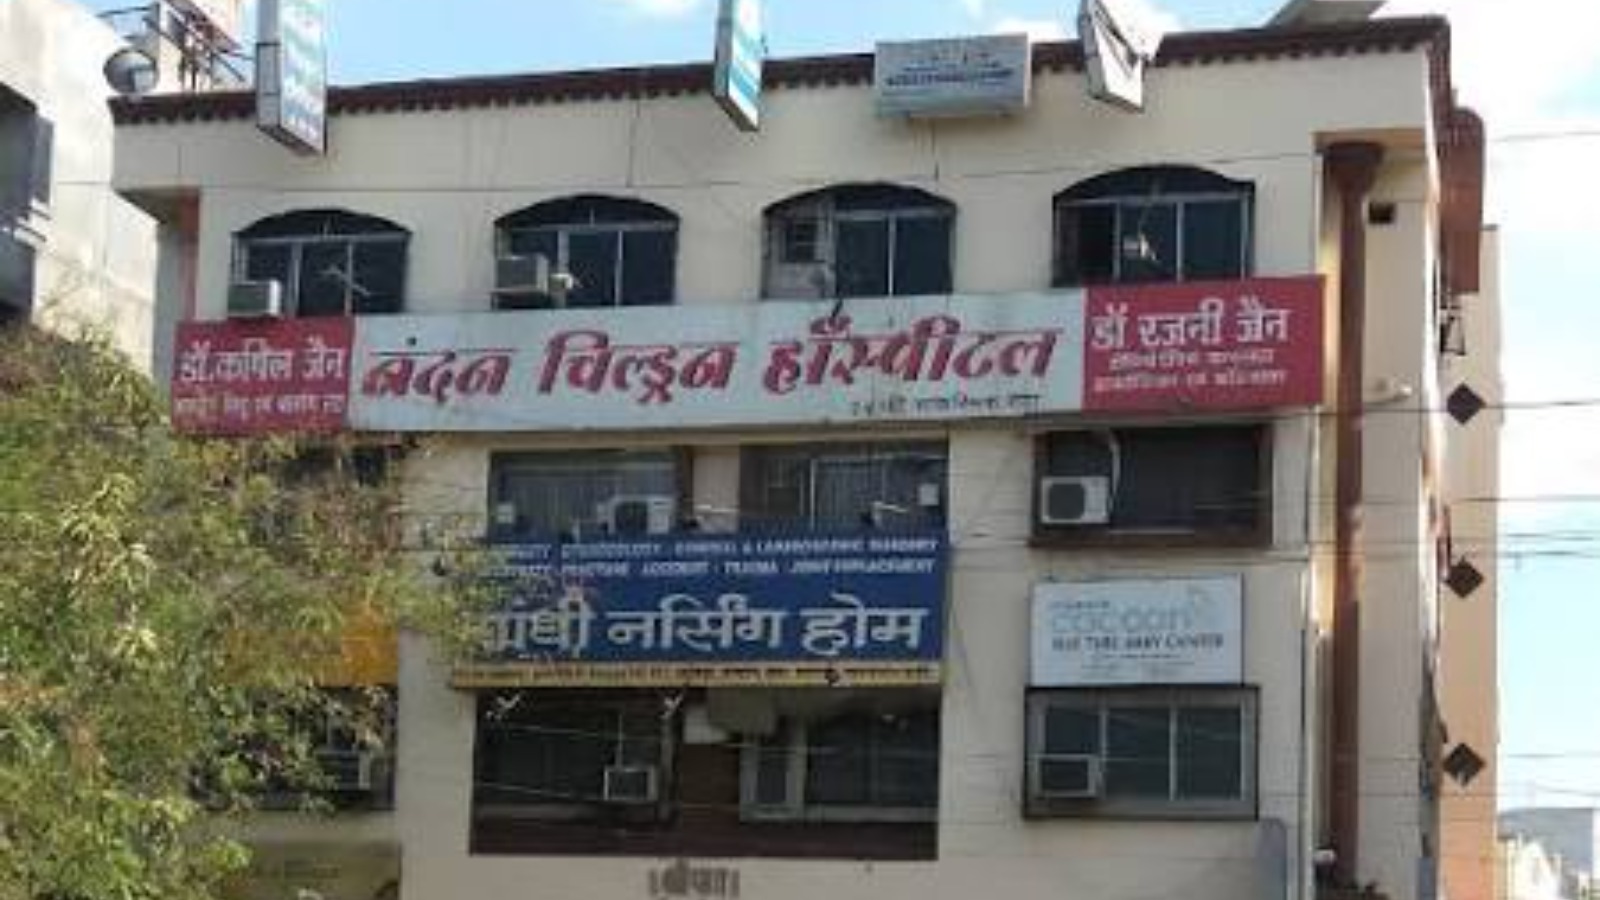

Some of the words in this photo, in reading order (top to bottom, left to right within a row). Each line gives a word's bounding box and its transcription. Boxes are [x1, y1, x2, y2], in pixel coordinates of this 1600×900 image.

[1137, 297, 1225, 346] रजनी
[1236, 294, 1292, 343] जैन
[302, 334, 347, 379] जैन
[362, 335, 518, 402] नंदन
[538, 328, 740, 404] चिल्ड्रन
[605, 592, 787, 652] नर्सिंग
[799, 590, 930, 656] होम
